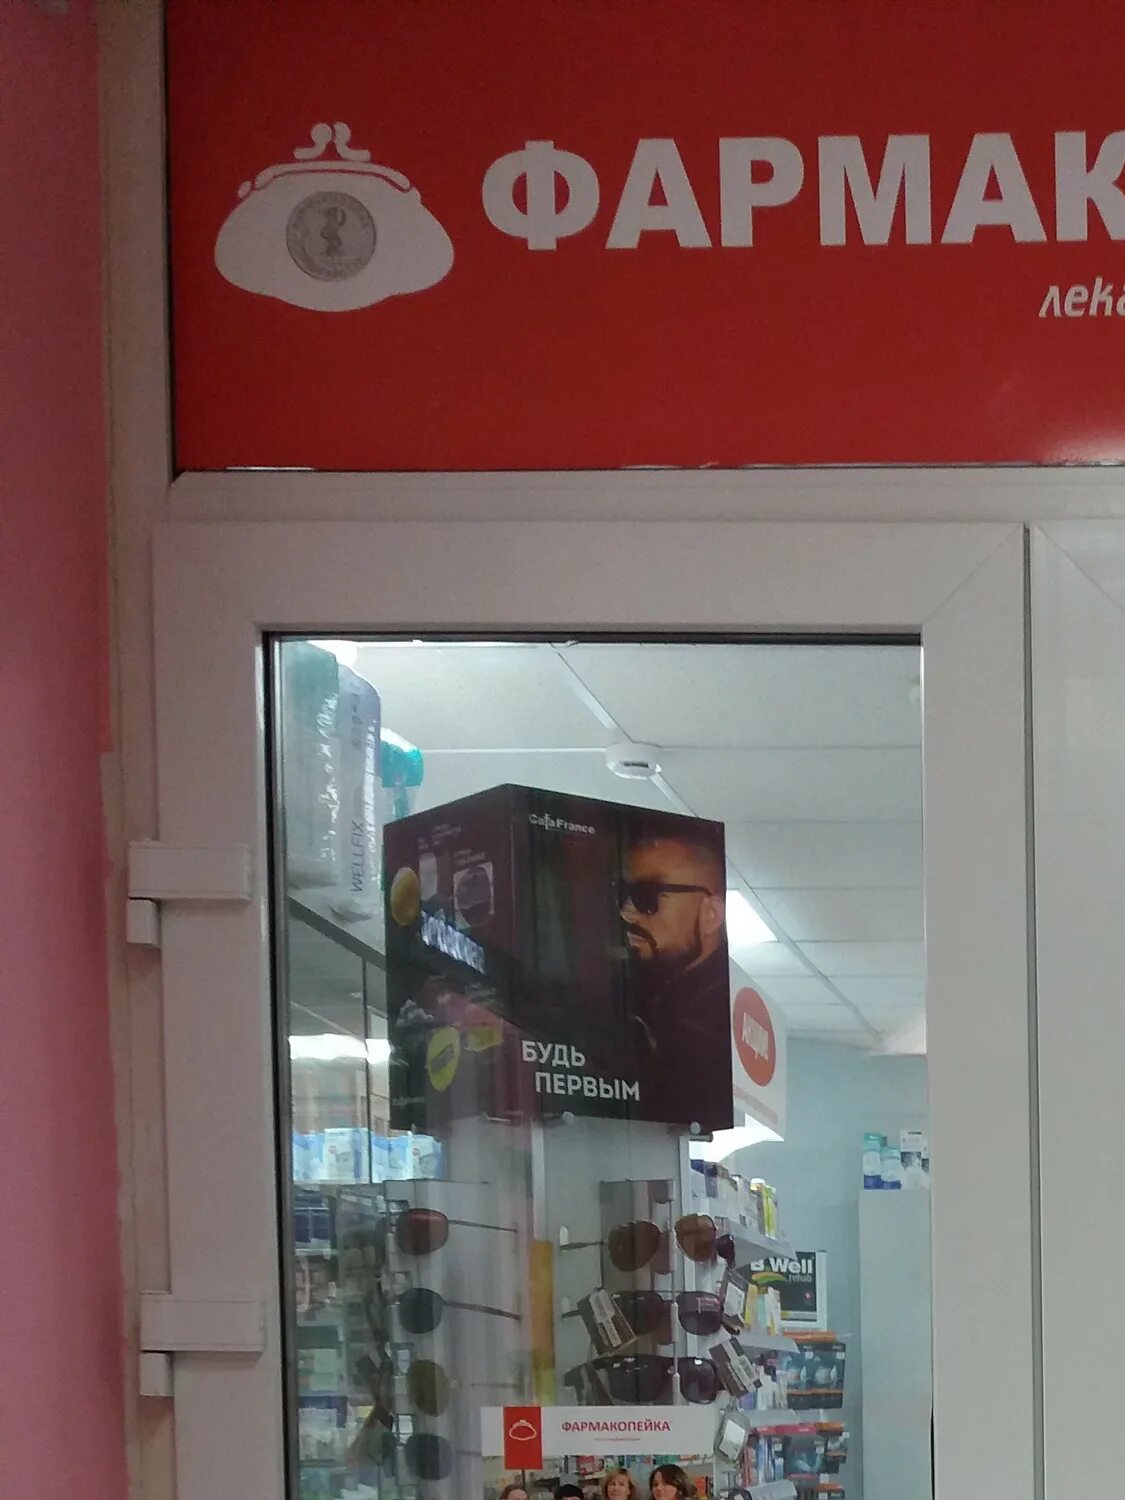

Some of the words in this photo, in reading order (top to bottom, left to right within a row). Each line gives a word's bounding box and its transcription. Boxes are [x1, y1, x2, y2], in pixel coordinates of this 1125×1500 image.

[351, 820, 365, 893] WELLFIX
[521, 1040, 586, 1068] БУДЬ
[535, 1071, 641, 1102] ПЕРВЫМ
[769, 1257, 813, 1275] Well
[561, 1418, 671, 1432] ФАРМАКОПЕЙКА
